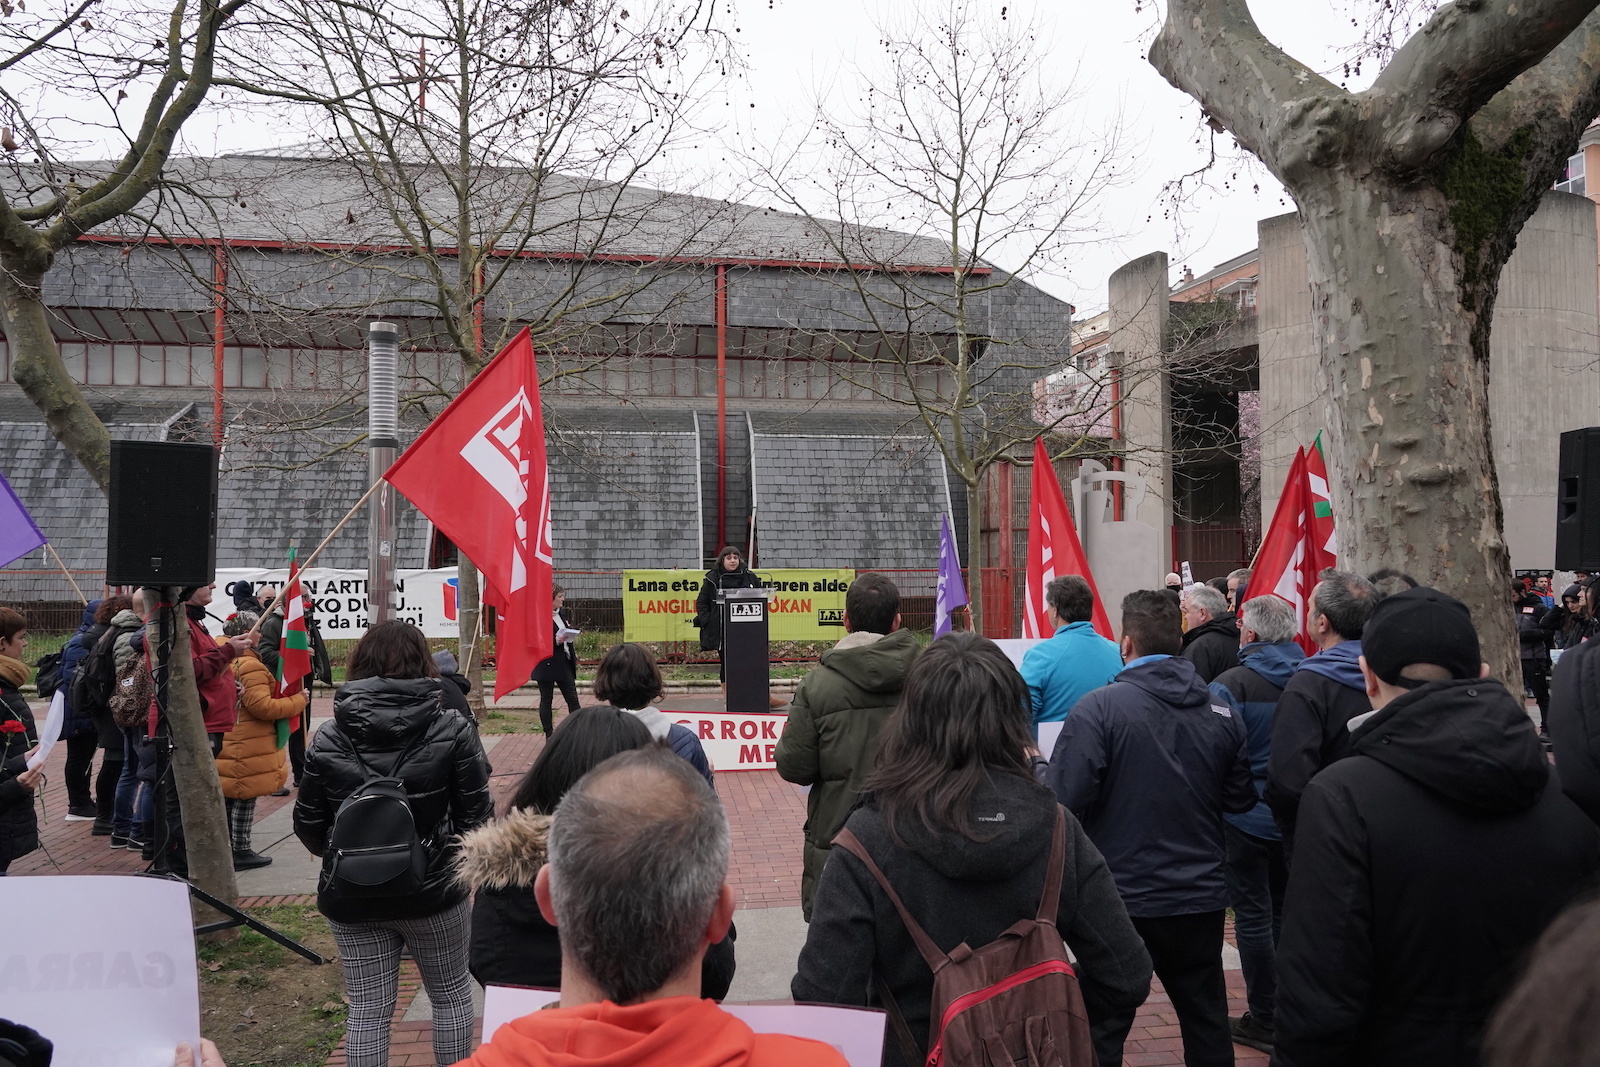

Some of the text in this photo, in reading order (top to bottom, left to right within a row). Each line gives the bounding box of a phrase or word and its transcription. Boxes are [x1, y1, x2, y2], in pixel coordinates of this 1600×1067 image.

[324, 578, 404, 595] ARTN
[628, 578, 699, 592] Lana eta
[813, 578, 848, 592] alde
[732, 604, 761, 616] LAB
[328, 614, 350, 629] da
[738, 744, 776, 764] ME
